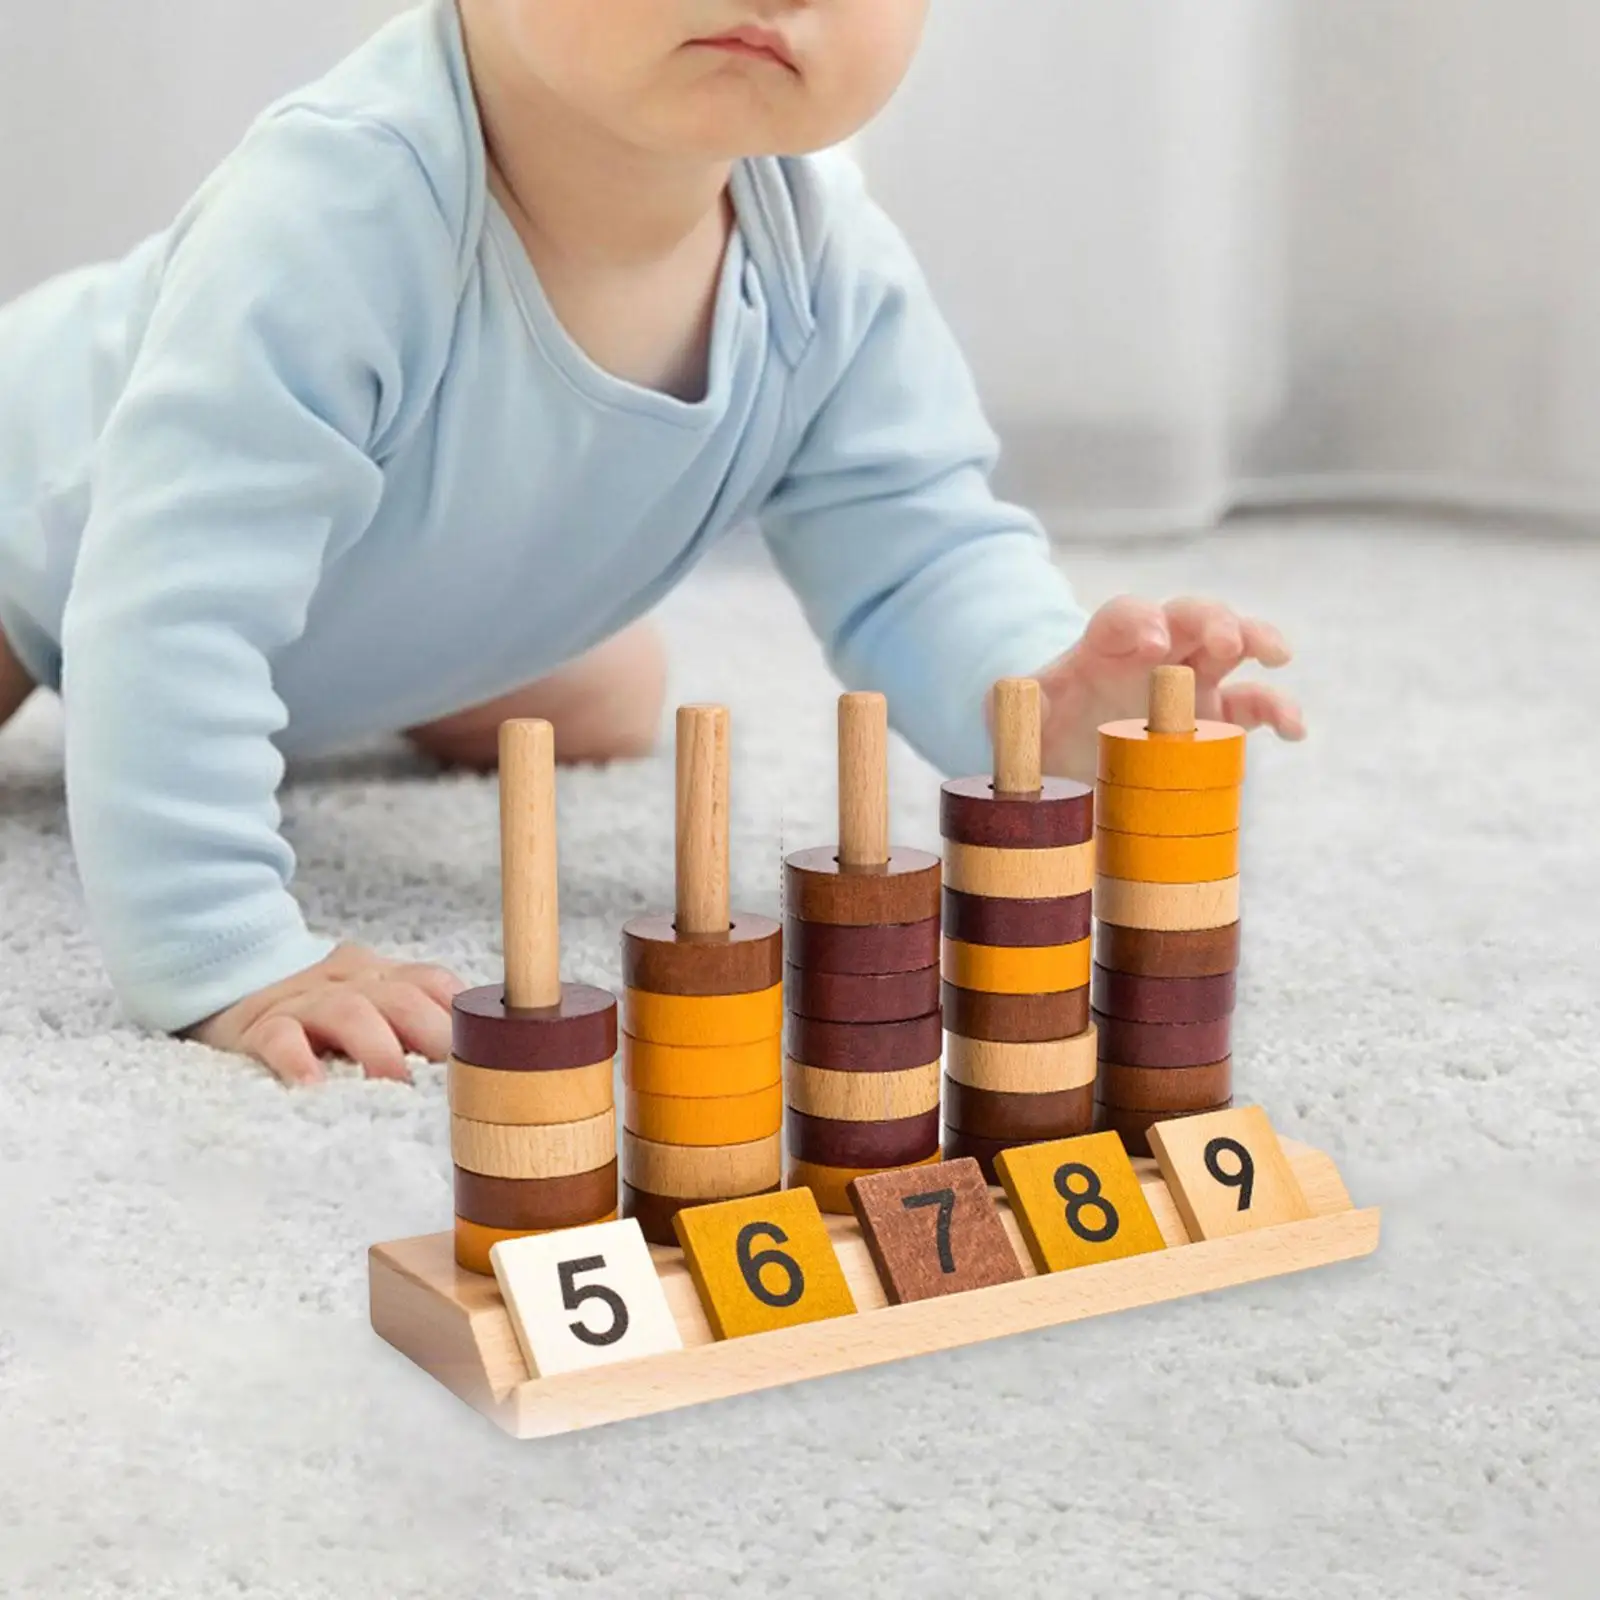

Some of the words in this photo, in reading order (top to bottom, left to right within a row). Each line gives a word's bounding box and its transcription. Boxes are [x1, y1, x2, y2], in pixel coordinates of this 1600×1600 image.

[1053, 1162, 1120, 1243] 8
[1203, 1136, 1255, 1212] 9
[736, 1221, 805, 1308] 6
[902, 1187, 956, 1274] 7
[556, 1254, 629, 1346] 5
